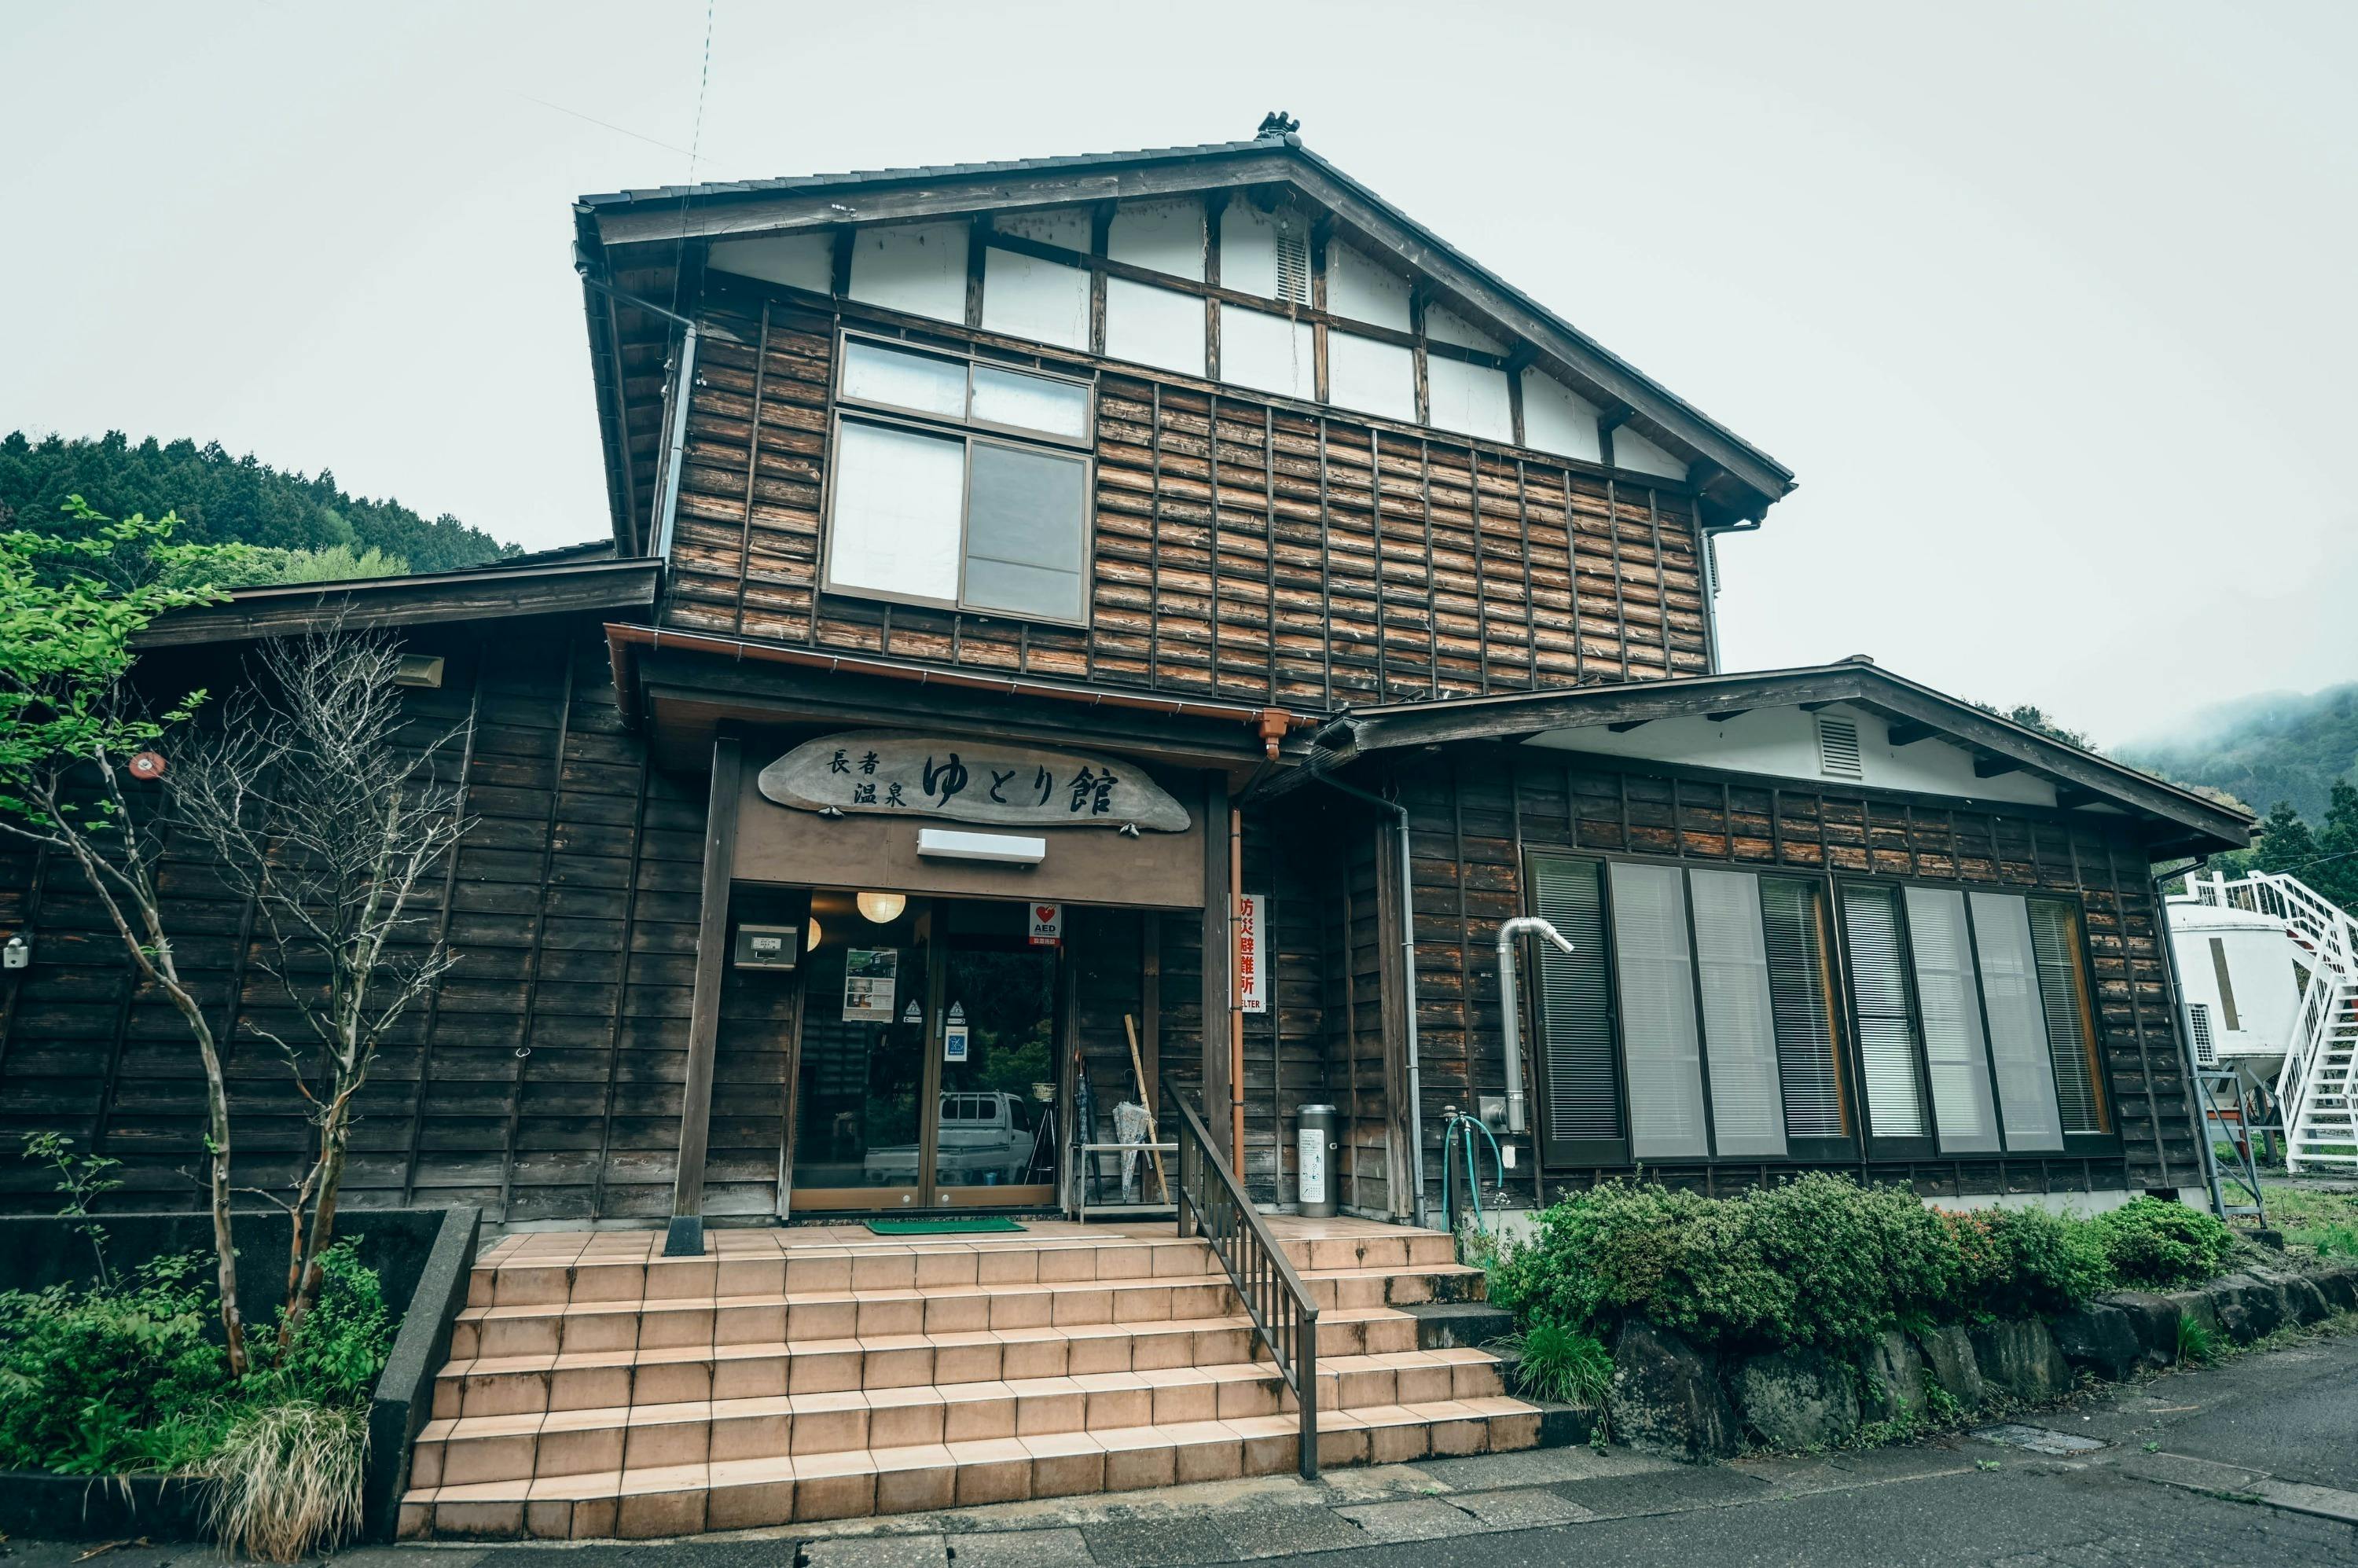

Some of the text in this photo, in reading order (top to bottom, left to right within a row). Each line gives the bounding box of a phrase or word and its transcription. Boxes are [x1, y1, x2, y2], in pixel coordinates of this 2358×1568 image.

[826, 748, 880, 775] 長者
[854, 781, 907, 807] 温泉
[922, 752, 1119, 816] ゆとり館
